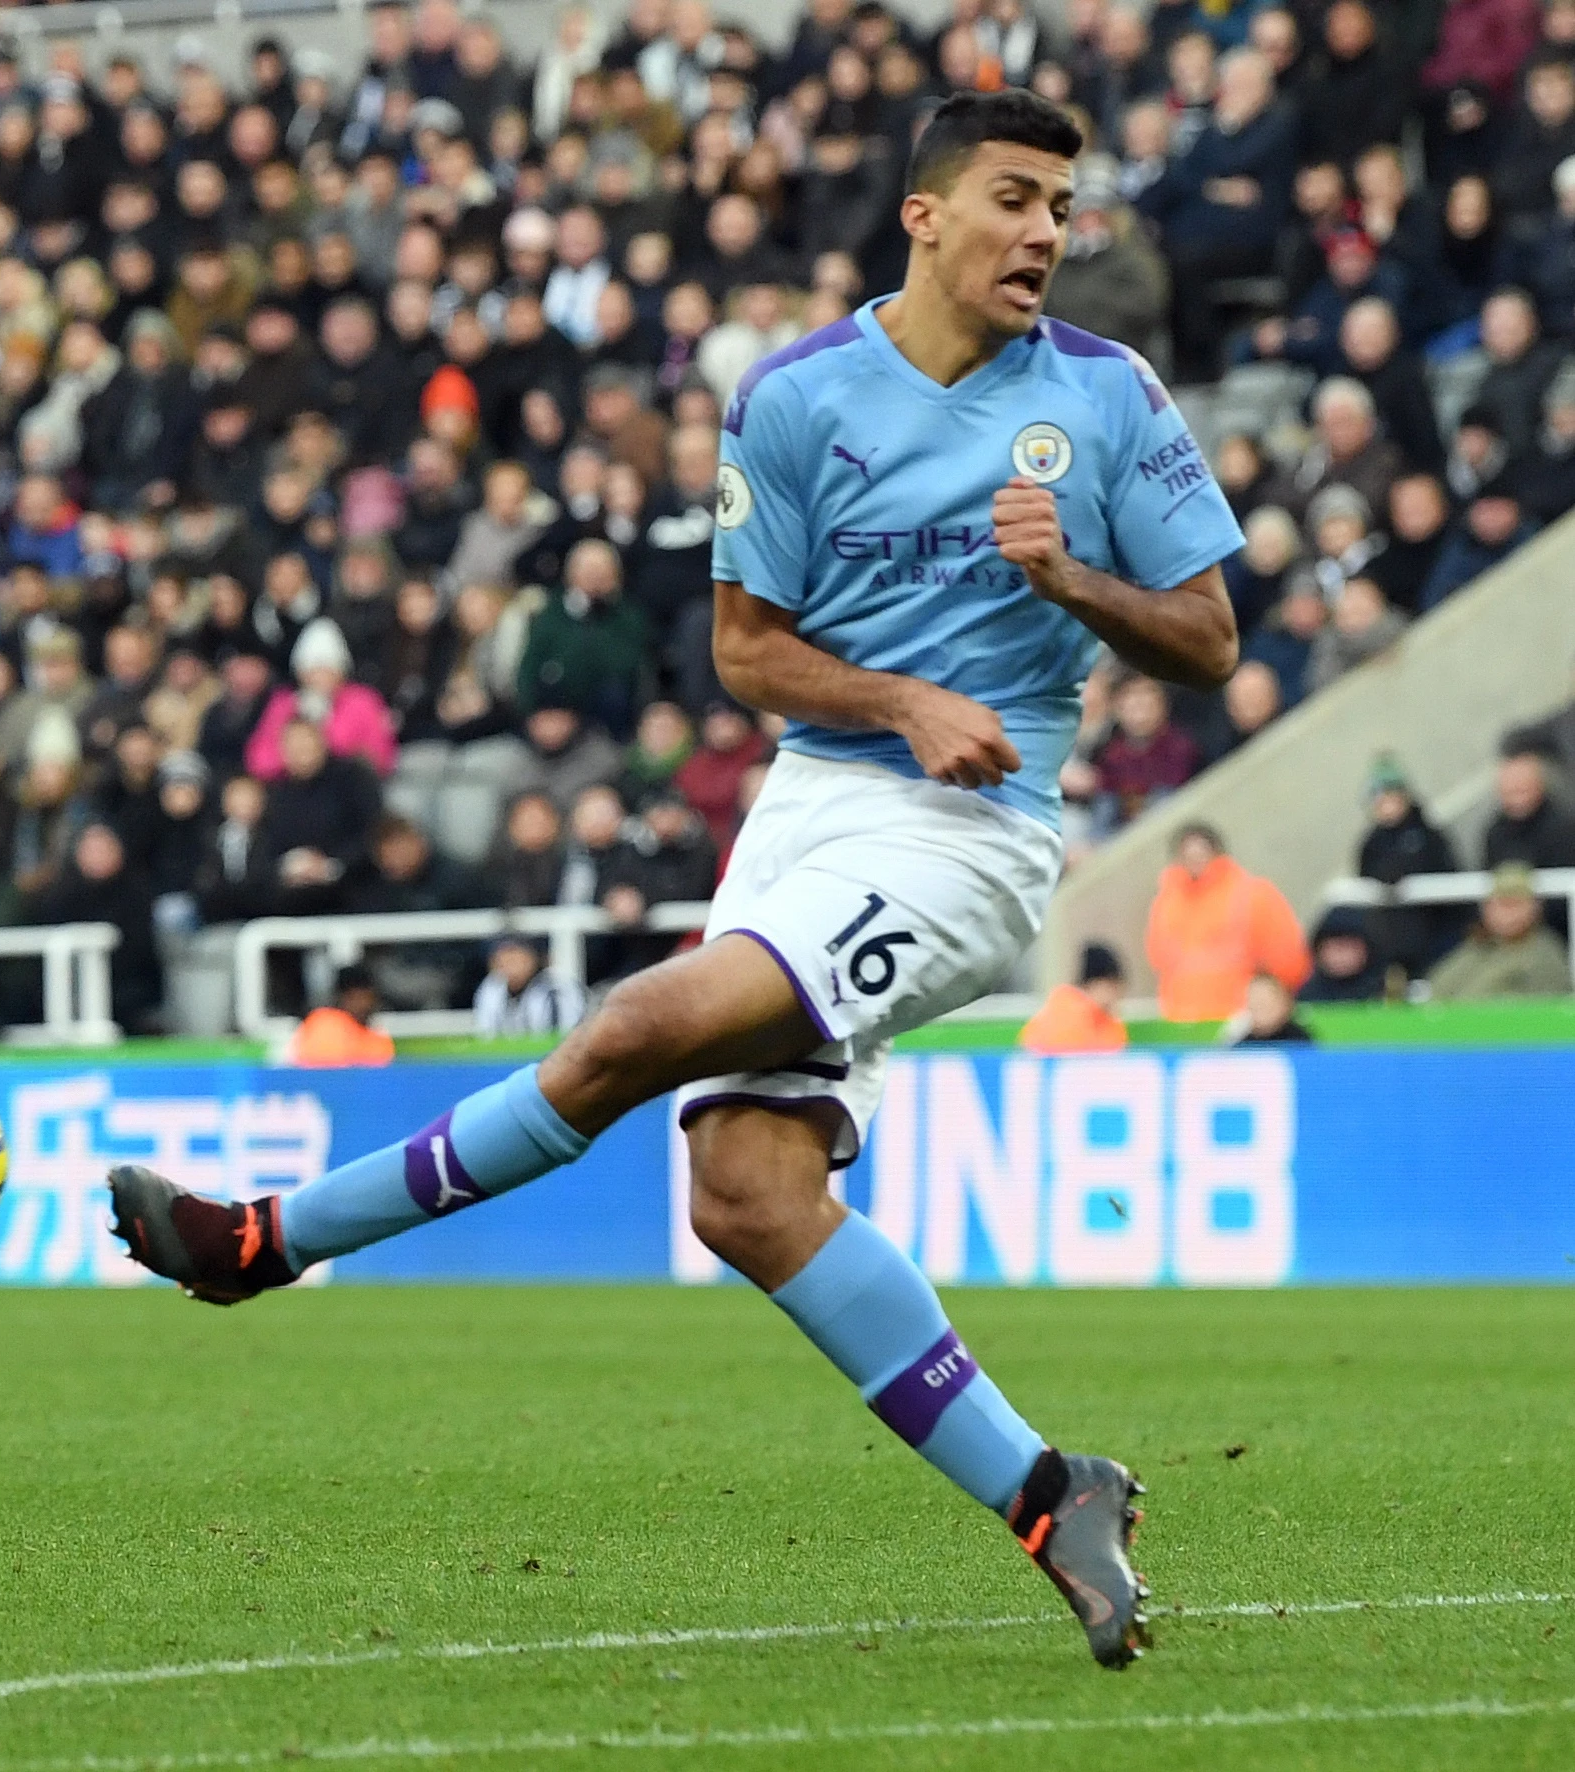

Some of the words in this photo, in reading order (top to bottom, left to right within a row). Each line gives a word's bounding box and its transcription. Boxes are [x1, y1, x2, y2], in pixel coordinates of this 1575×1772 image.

[1137, 431, 1198, 481] NEXE
[871, 562, 1027, 592] AIRWAYS
[824, 892, 919, 996] 16
[922, 1340, 969, 1388] CITY
